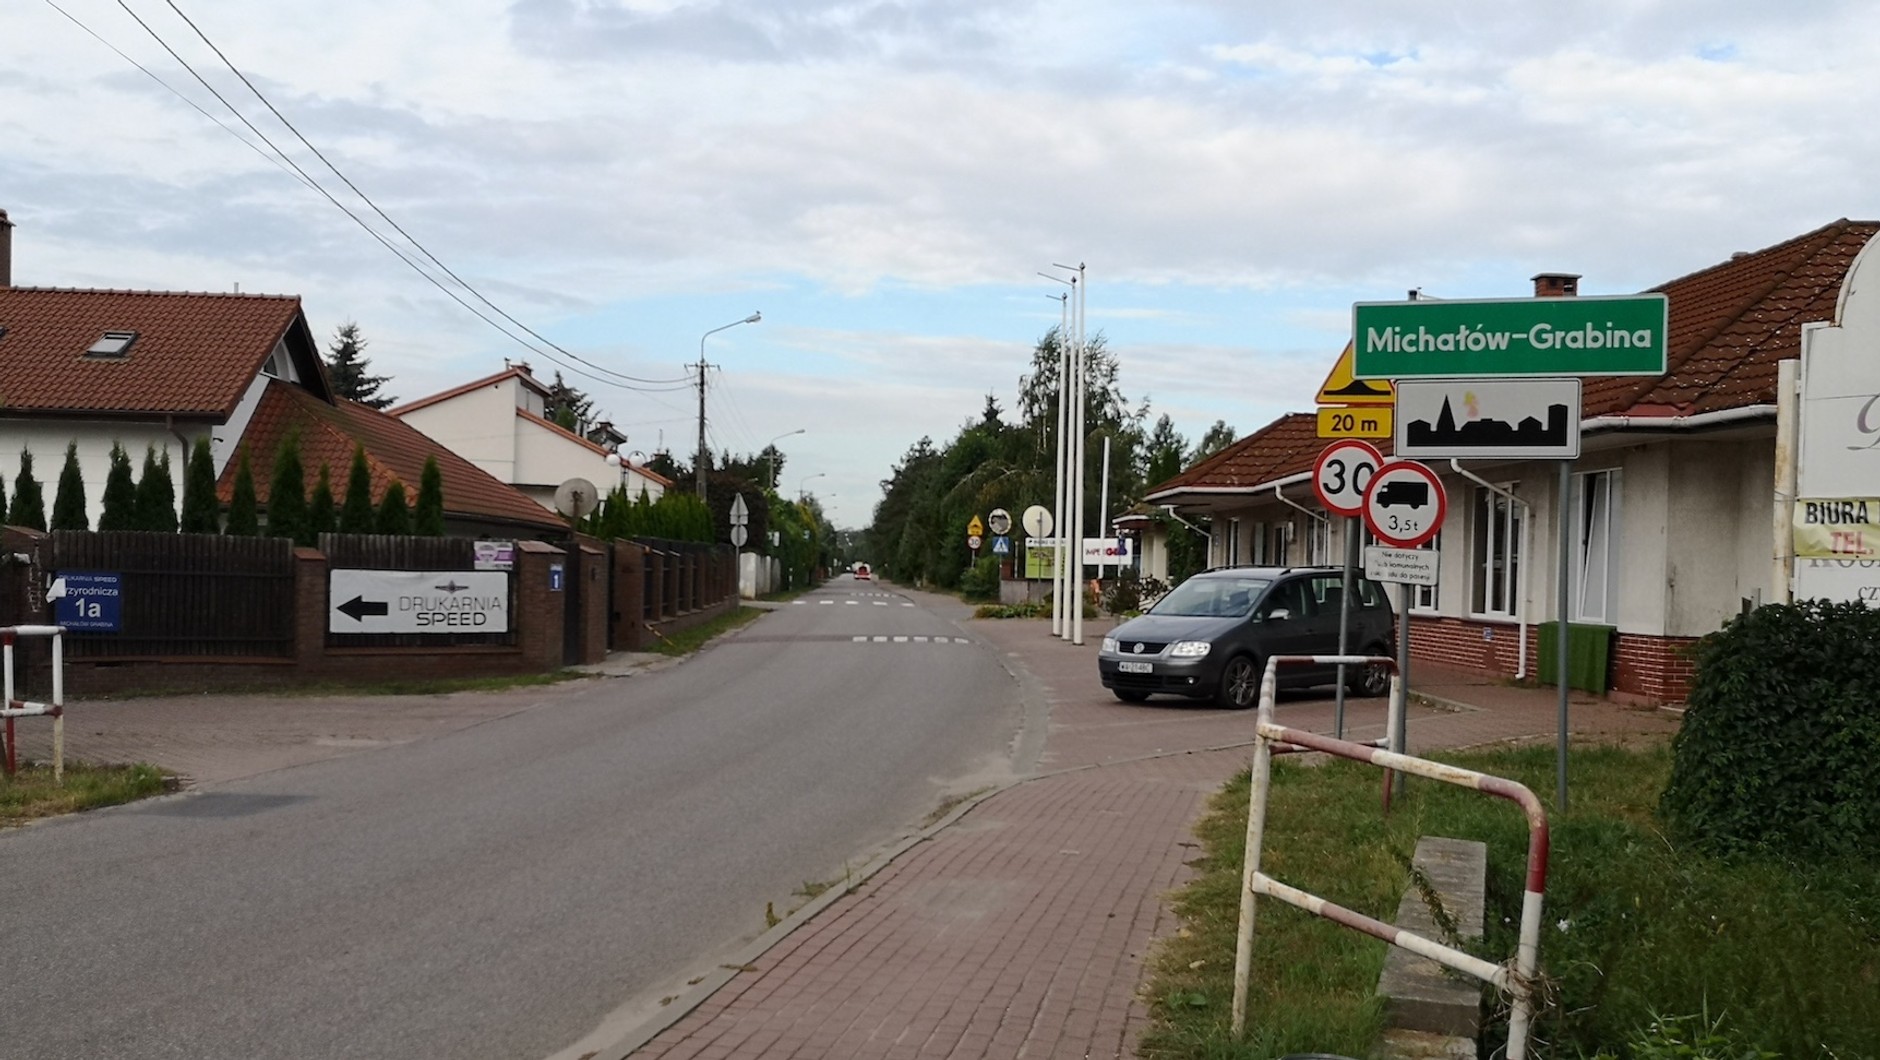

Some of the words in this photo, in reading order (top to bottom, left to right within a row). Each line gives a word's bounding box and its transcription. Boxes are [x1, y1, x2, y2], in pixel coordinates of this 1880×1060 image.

[1366, 321, 1652, 353] Michałów-Grabina
[1331, 414, 1355, 432] 20
[1361, 419, 1378, 432] m
[1322, 459, 1375, 497] 30
[1804, 501, 1869, 525] BIURA
[1830, 531, 1874, 555] TEL.
[1394, 551, 1419, 561] dotyczy
[65, 586, 119, 597] rzyrodnicza
[75, 598, 101, 618] 1a
[399, 595, 503, 612] DRUKARNIA
[416, 612, 487, 626] SPEED
